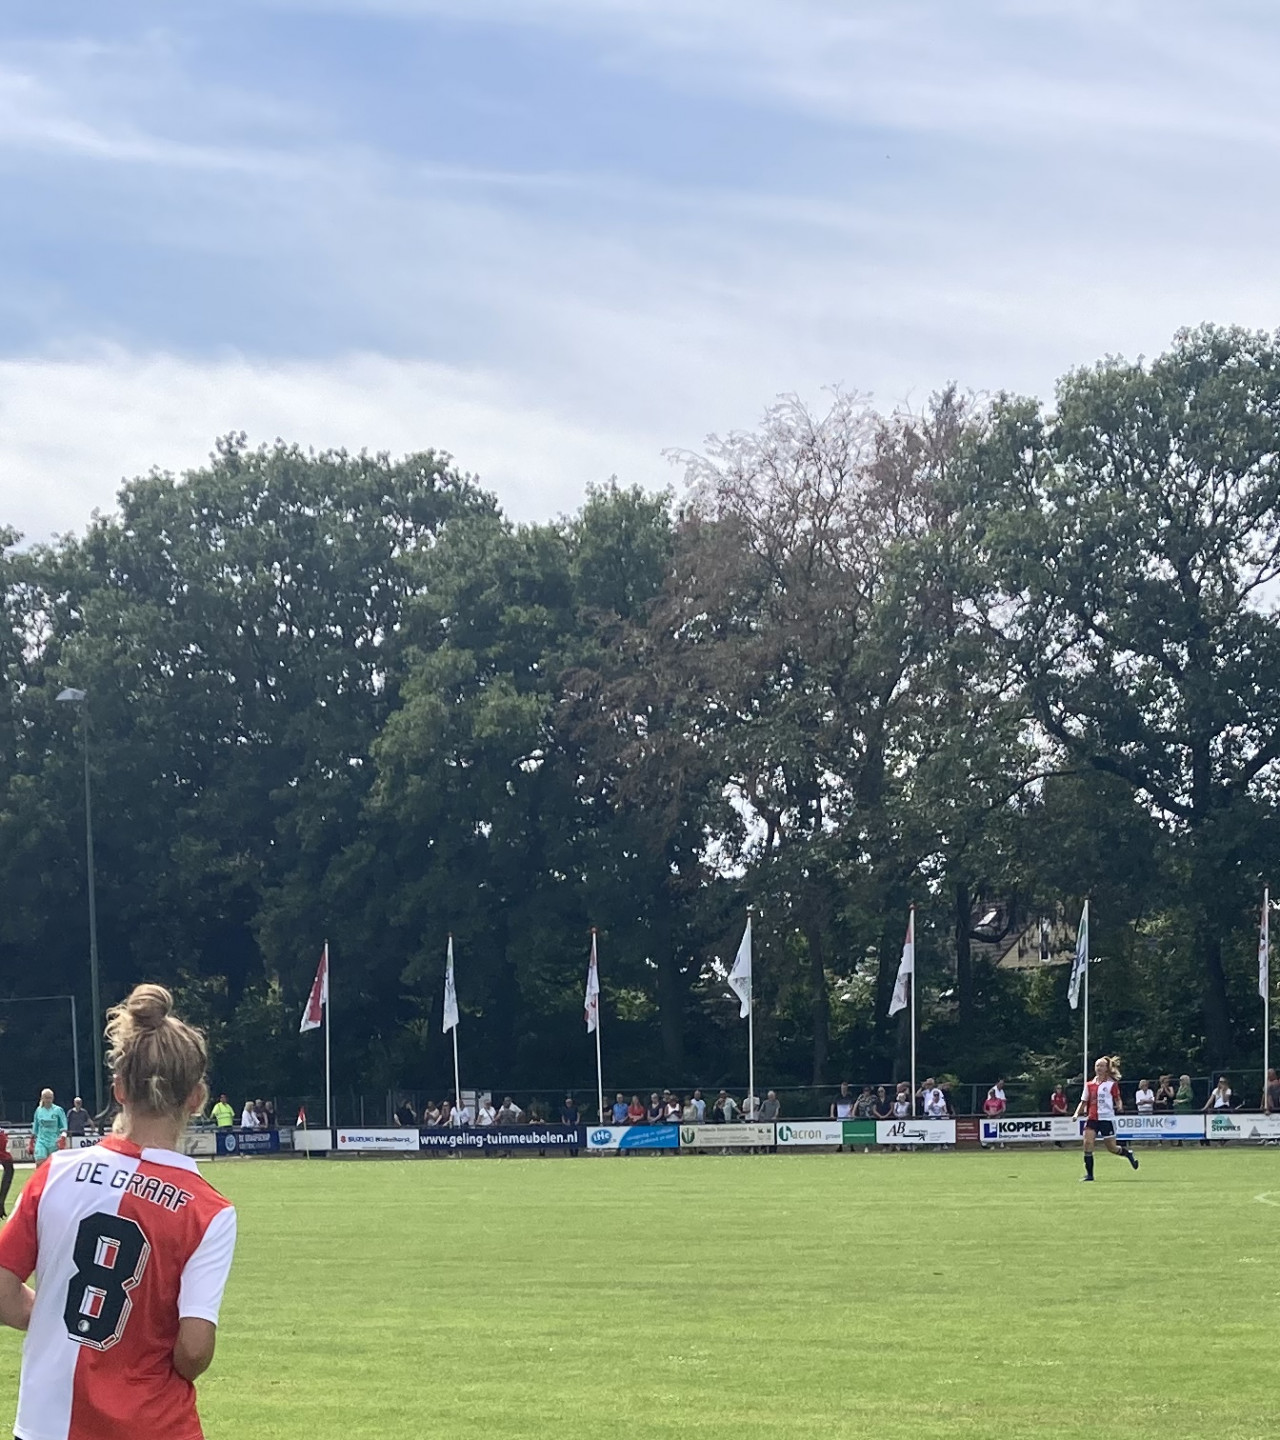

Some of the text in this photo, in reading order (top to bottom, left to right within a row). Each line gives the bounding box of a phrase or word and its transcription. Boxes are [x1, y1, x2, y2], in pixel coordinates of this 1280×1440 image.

[419, 1130, 578, 1148] www.geling-tuinmeubelen.nl
[999, 1121, 1052, 1133] KOPPELE
[75, 1162, 195, 1213] DE GRAAF
[63, 1211, 151, 1351] 8
